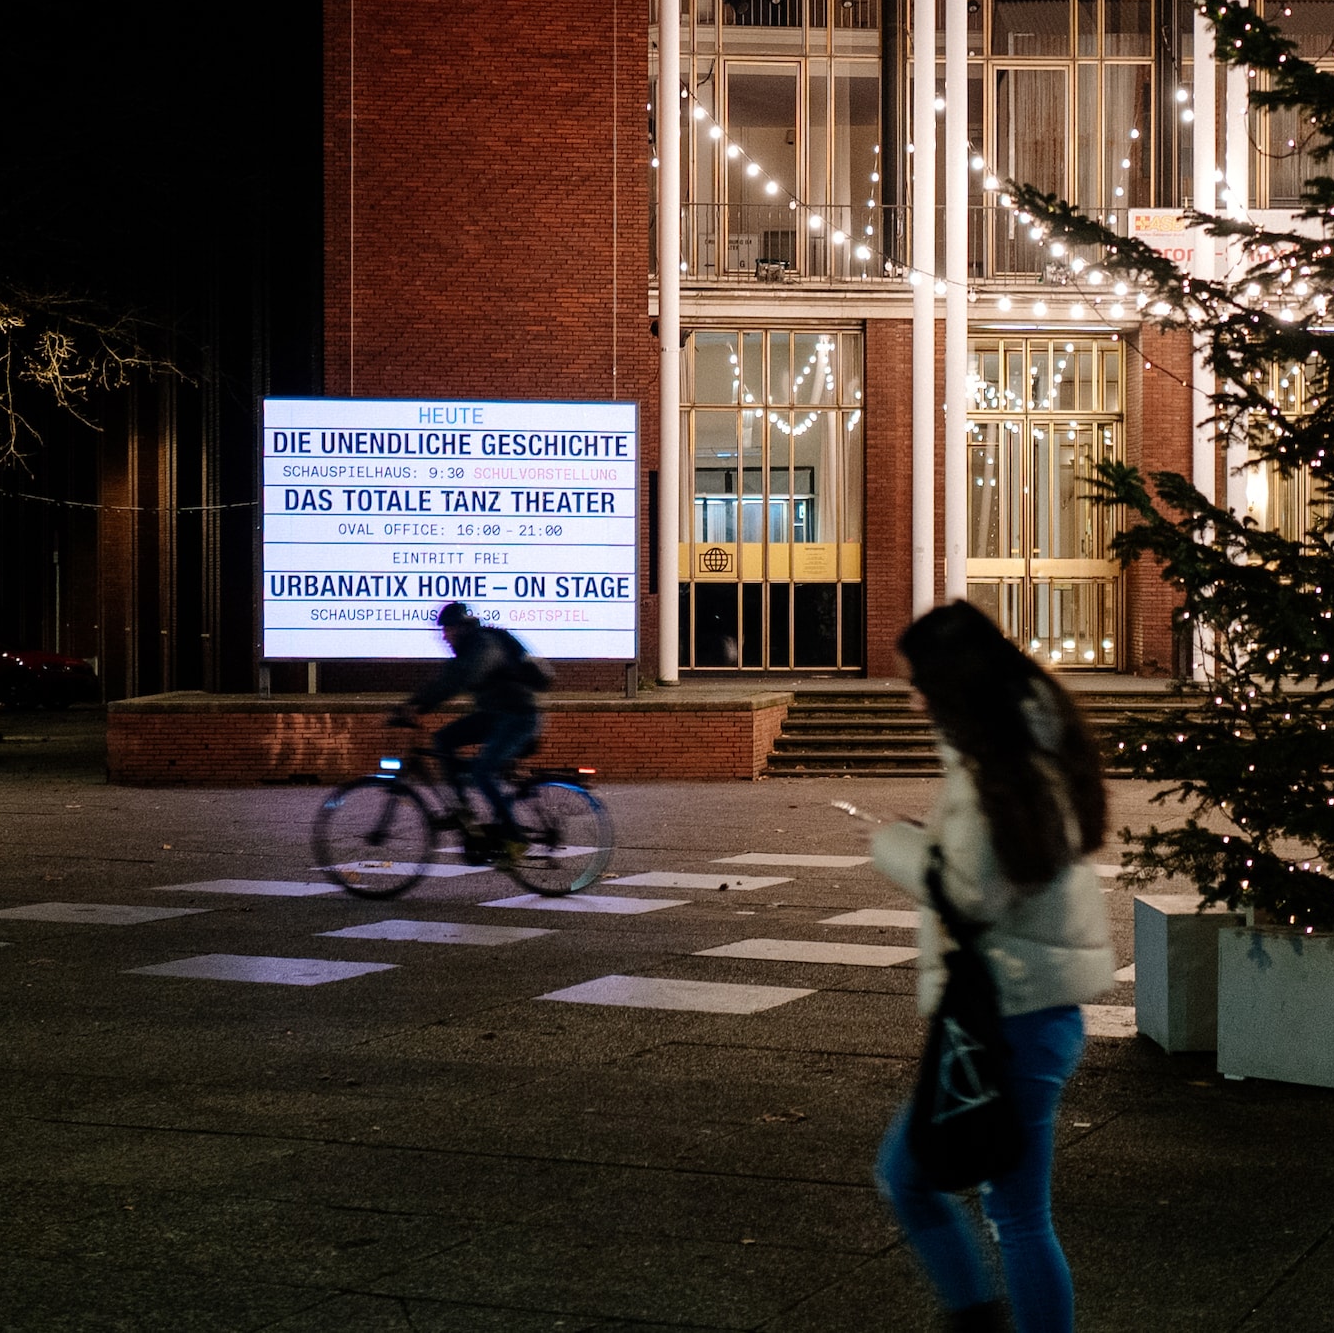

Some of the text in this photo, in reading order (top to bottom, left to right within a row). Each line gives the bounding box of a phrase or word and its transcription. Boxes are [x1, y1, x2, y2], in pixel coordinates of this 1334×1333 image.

[419, 407, 484, 424] HEUTE
[273, 432, 628, 456] DIE UNENDLICHE GESCHICHTE
[282, 465, 617, 481] SCHAUSPIELHAUS: 9:30 SCHULVORSTELLUNG
[285, 489, 615, 513] DAS TOTALE TANZ THEATER
[338, 523, 374, 535] OVAL
[384, 524, 445, 536] OFFICE:
[457, 524, 501, 536] 16:00
[519, 525, 563, 536] 21:00
[393, 552, 509, 564] EINTRITT FREI
[270, 575, 408, 597] URBANATIX
[419, 576, 486, 597] HOME
[514, 576, 545, 598] ON
[556, 576, 629, 598] STAGE
[509, 609, 589, 622] GASTSPIEL
